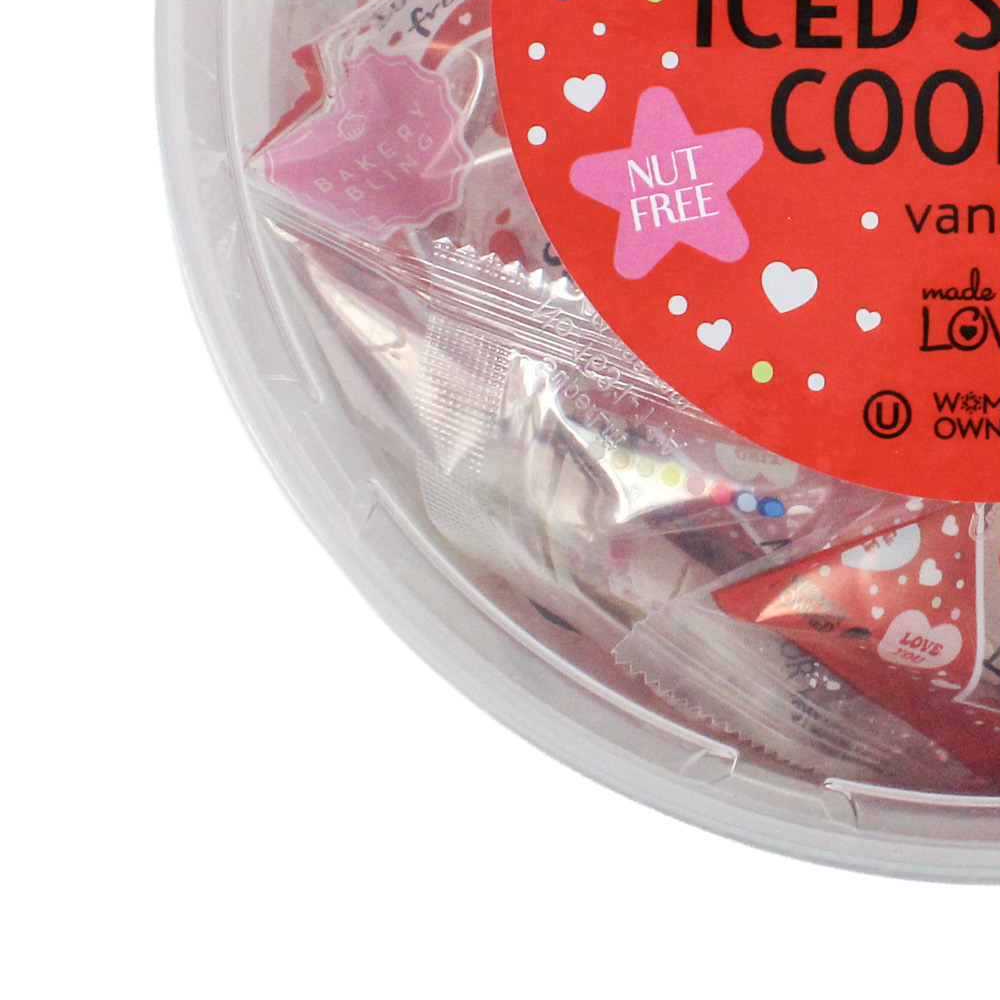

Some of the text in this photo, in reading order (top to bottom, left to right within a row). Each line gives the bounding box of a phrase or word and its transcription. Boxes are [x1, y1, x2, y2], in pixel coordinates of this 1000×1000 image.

[314, 101, 427, 192] BAKERY
[345, 132, 433, 201] BLING
[627, 145, 703, 192] NUT
[630, 182, 720, 231] FREE
[922, 267, 996, 300] made
[900, 631, 943, 656] LOVE
